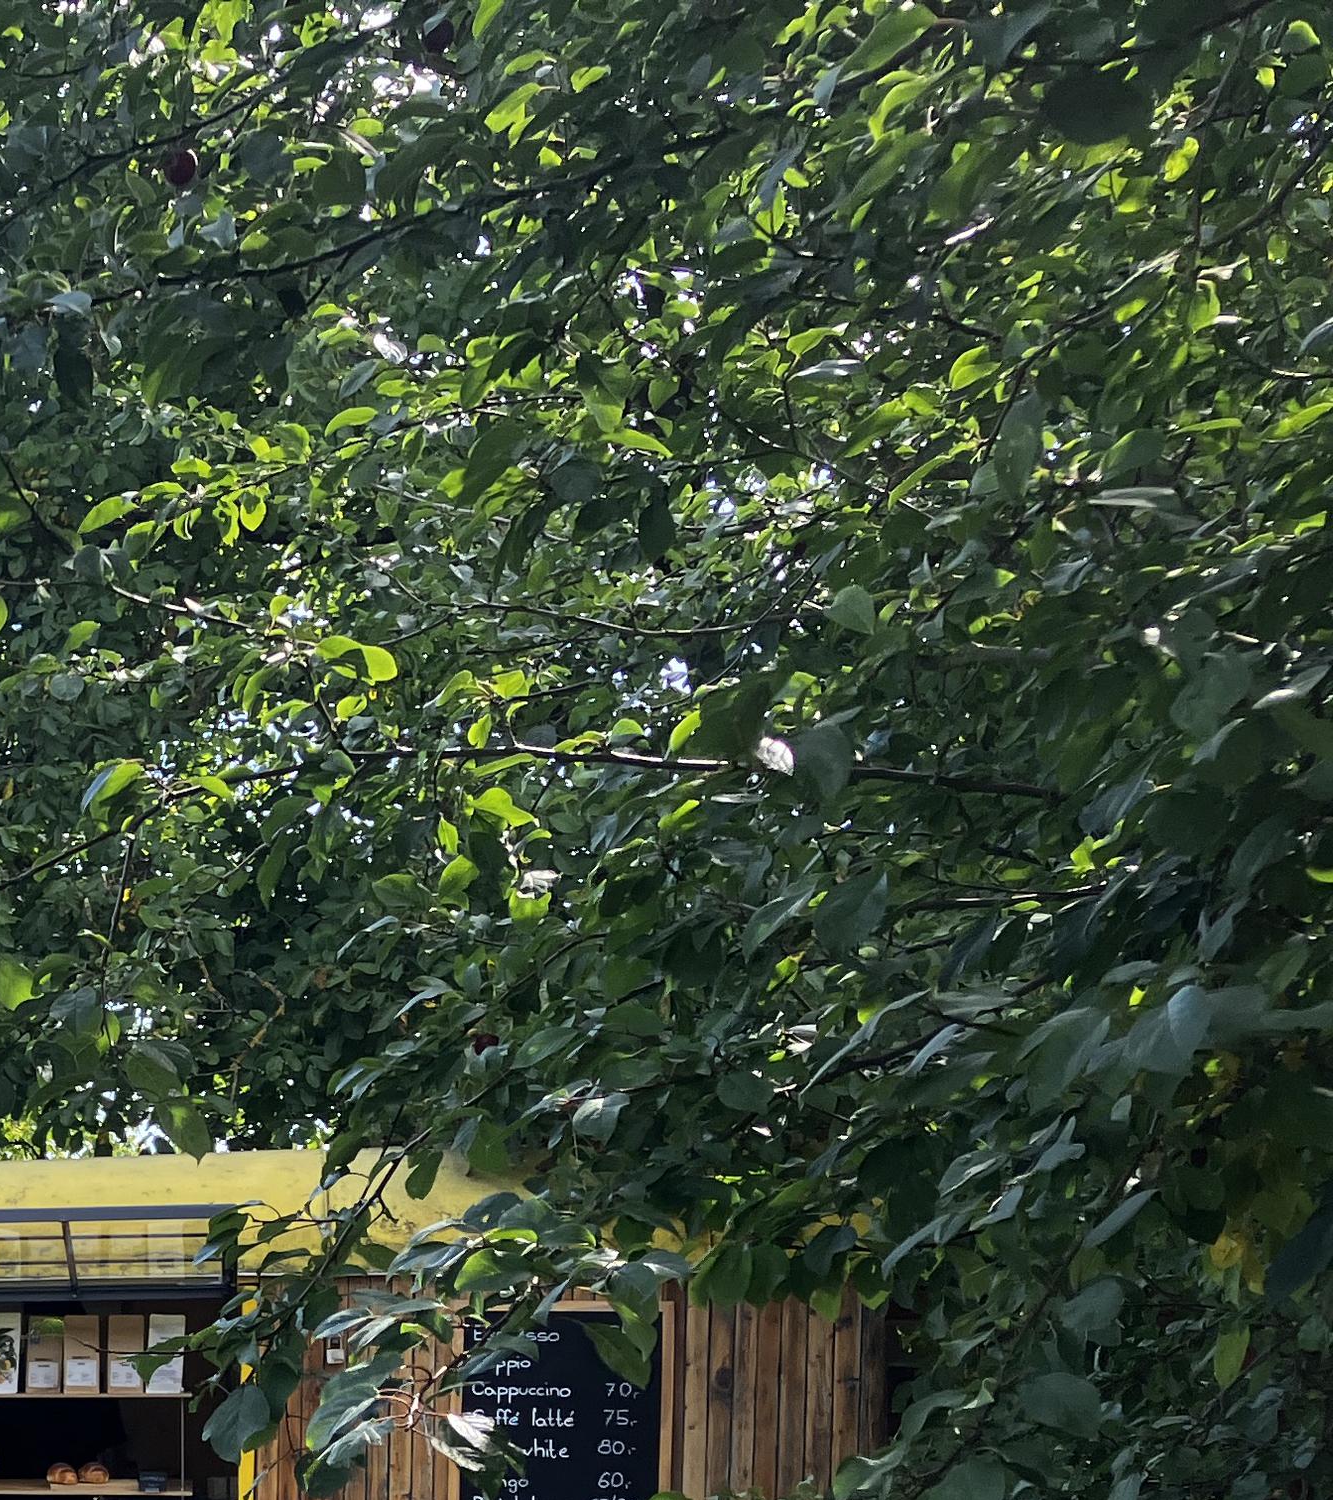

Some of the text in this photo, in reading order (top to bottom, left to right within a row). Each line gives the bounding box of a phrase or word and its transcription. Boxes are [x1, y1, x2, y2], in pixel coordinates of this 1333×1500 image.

[473, 1328, 560, 1342] Esso
[471, 1382, 572, 1404] Cappuccino
[531, 1407, 575, 1428] latté
